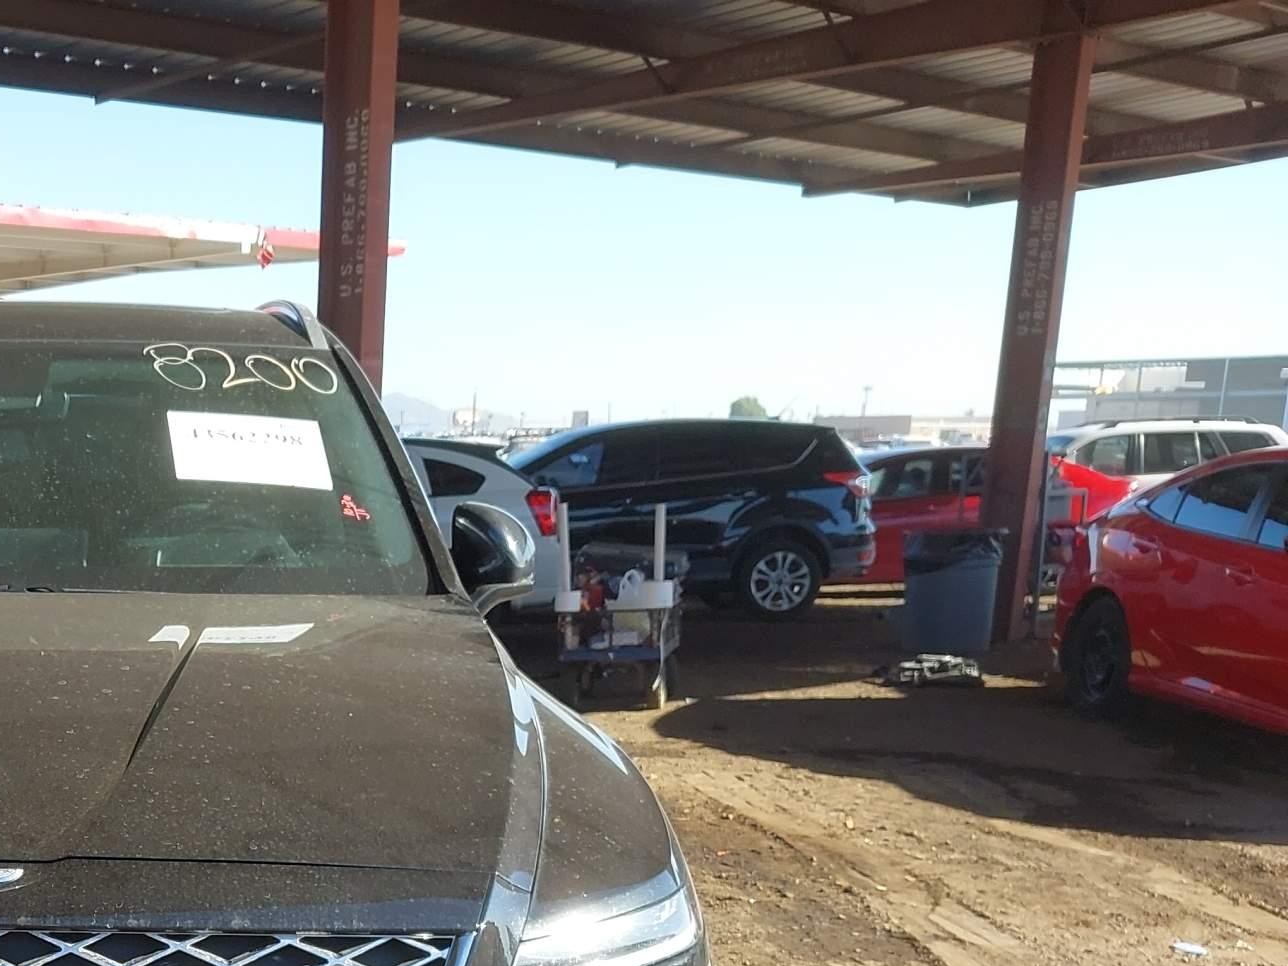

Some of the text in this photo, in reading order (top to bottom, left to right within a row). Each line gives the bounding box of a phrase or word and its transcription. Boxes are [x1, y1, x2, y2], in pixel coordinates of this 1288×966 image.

[338, 108, 359, 298] U.S. PREFAB INC.
[144, 343, 339, 394] 8200
